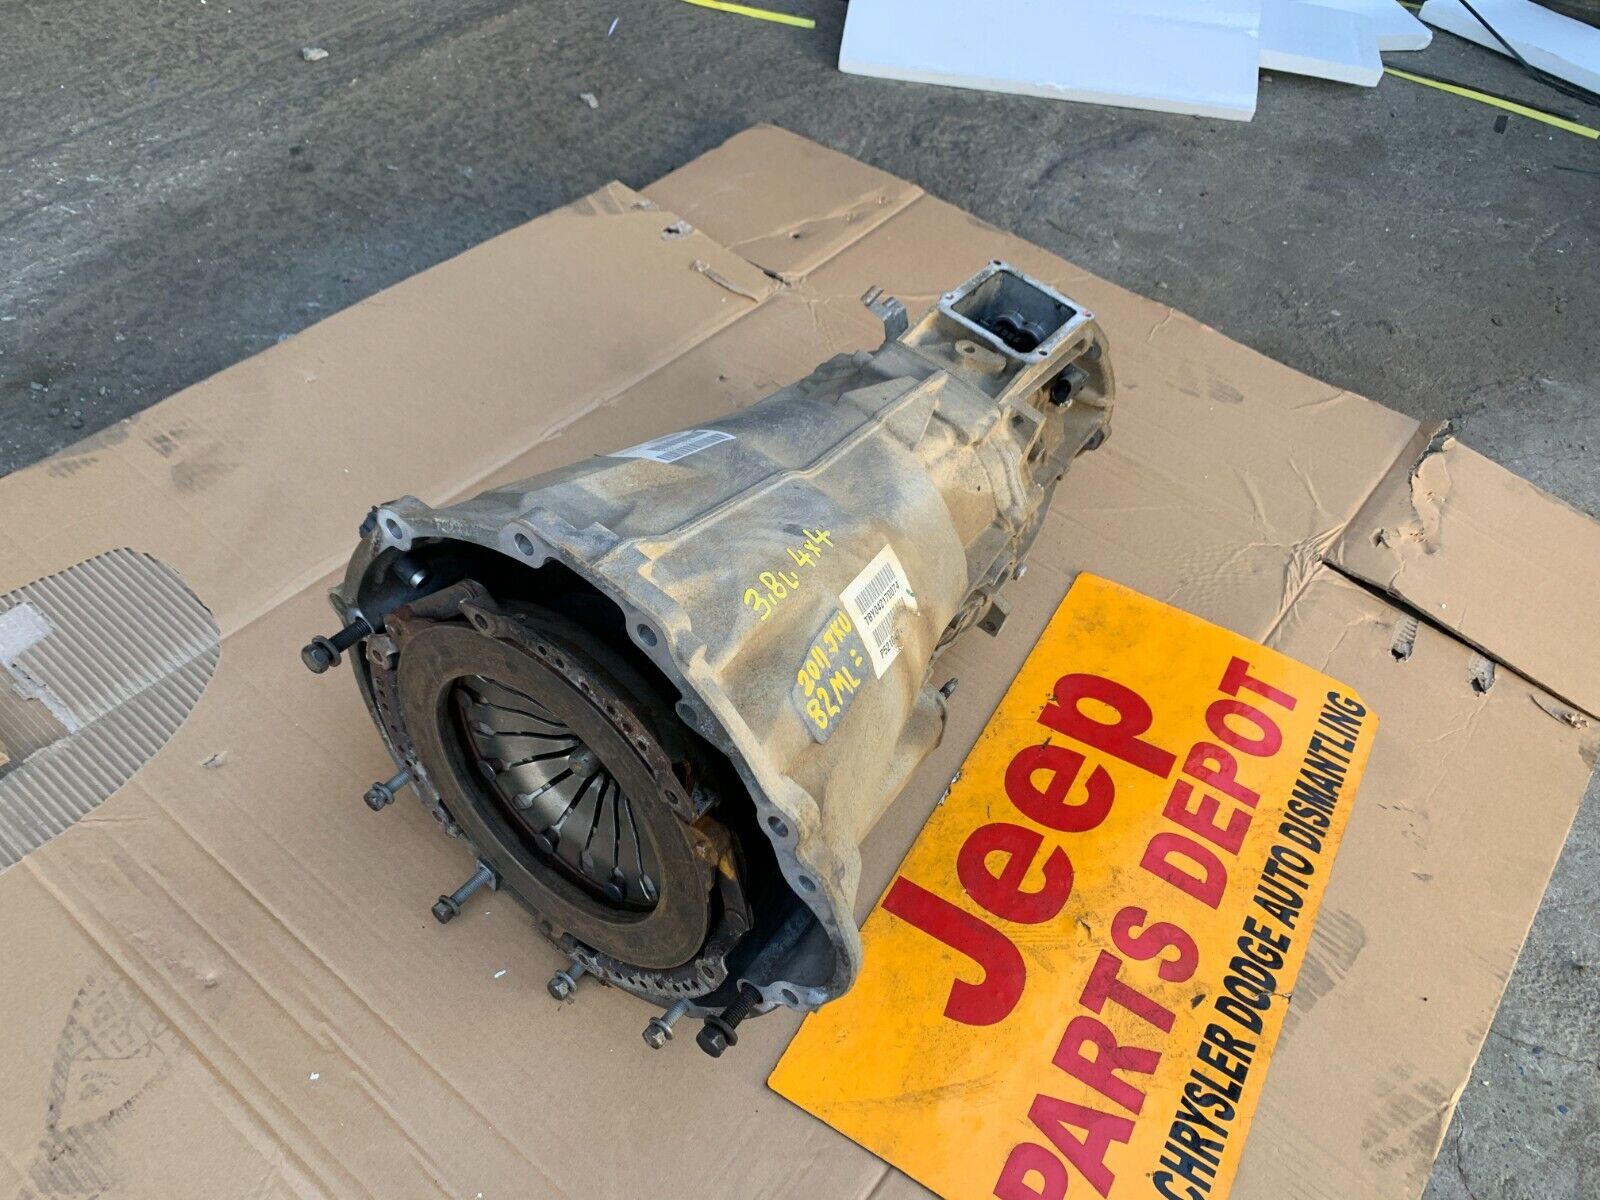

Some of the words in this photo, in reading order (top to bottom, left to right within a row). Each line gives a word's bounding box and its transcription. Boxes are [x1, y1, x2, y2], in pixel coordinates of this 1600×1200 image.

[798, 646, 831, 697] 2011
[881, 672, 1177, 1027] Jeep
[1278, 691, 1366, 854] DISMANTLING
[993, 905, 1199, 1200] PARTS
[1139, 656, 1298, 910] DEPOT
[1253, 845, 1315, 930] AUTO
[1214, 915, 1291, 1035] DODGE
[1152, 1023, 1256, 1200] CHRYSLER
